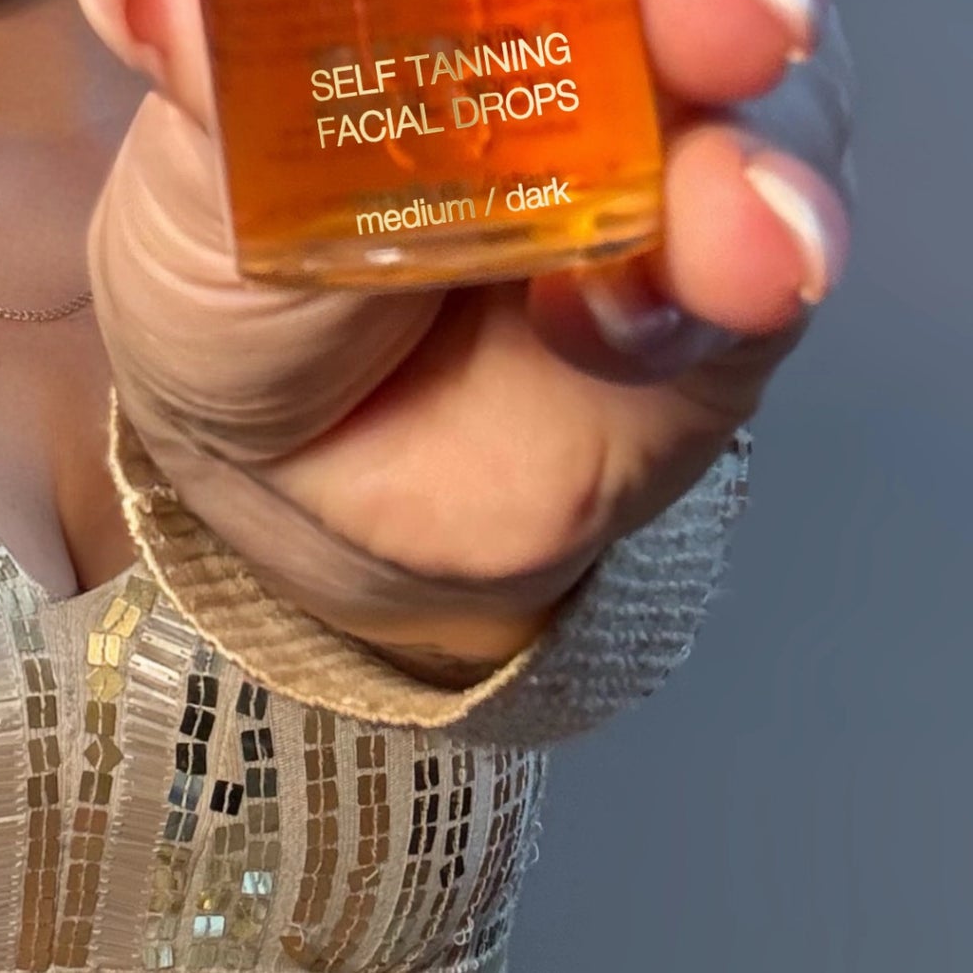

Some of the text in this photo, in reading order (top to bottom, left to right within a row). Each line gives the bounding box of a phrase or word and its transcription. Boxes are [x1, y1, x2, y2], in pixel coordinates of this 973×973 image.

[311, 32, 572, 102] SELF TANNING
[317, 79, 579, 149] FACIAL DROPS
[356, 177, 572, 235] medium / dark
